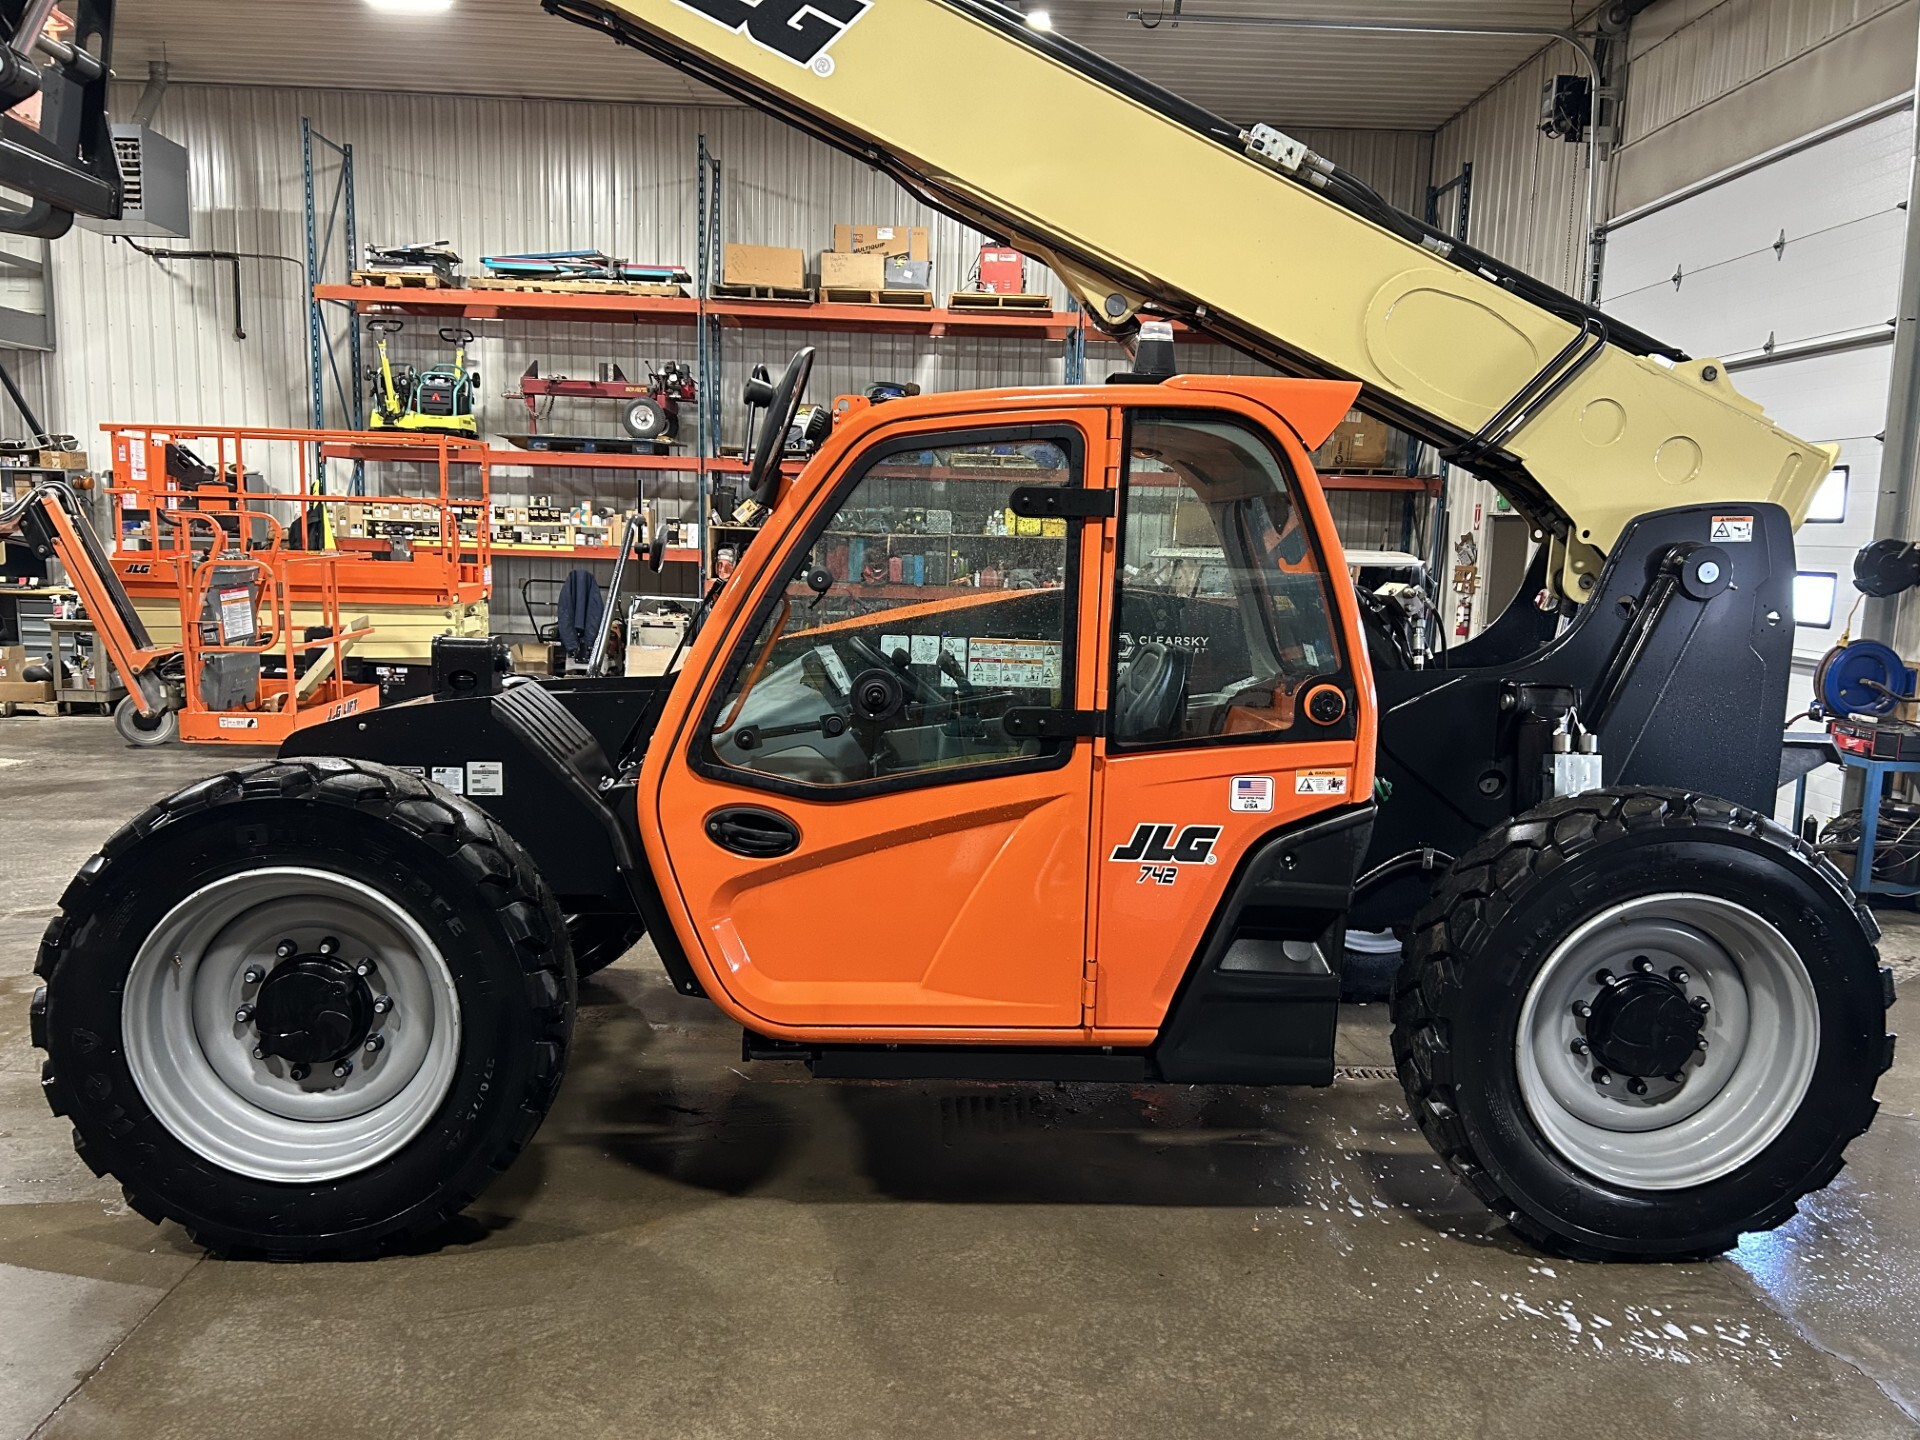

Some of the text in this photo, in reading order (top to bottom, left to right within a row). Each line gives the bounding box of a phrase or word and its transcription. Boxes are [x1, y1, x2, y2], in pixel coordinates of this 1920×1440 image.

[853, 242, 885, 253] MULTIQUIP
[124, 564, 150, 574] JLG
[1138, 635, 1209, 646] CLEARSKY
[1110, 824, 1221, 862] JLG
[1137, 865, 1178, 884] 742
